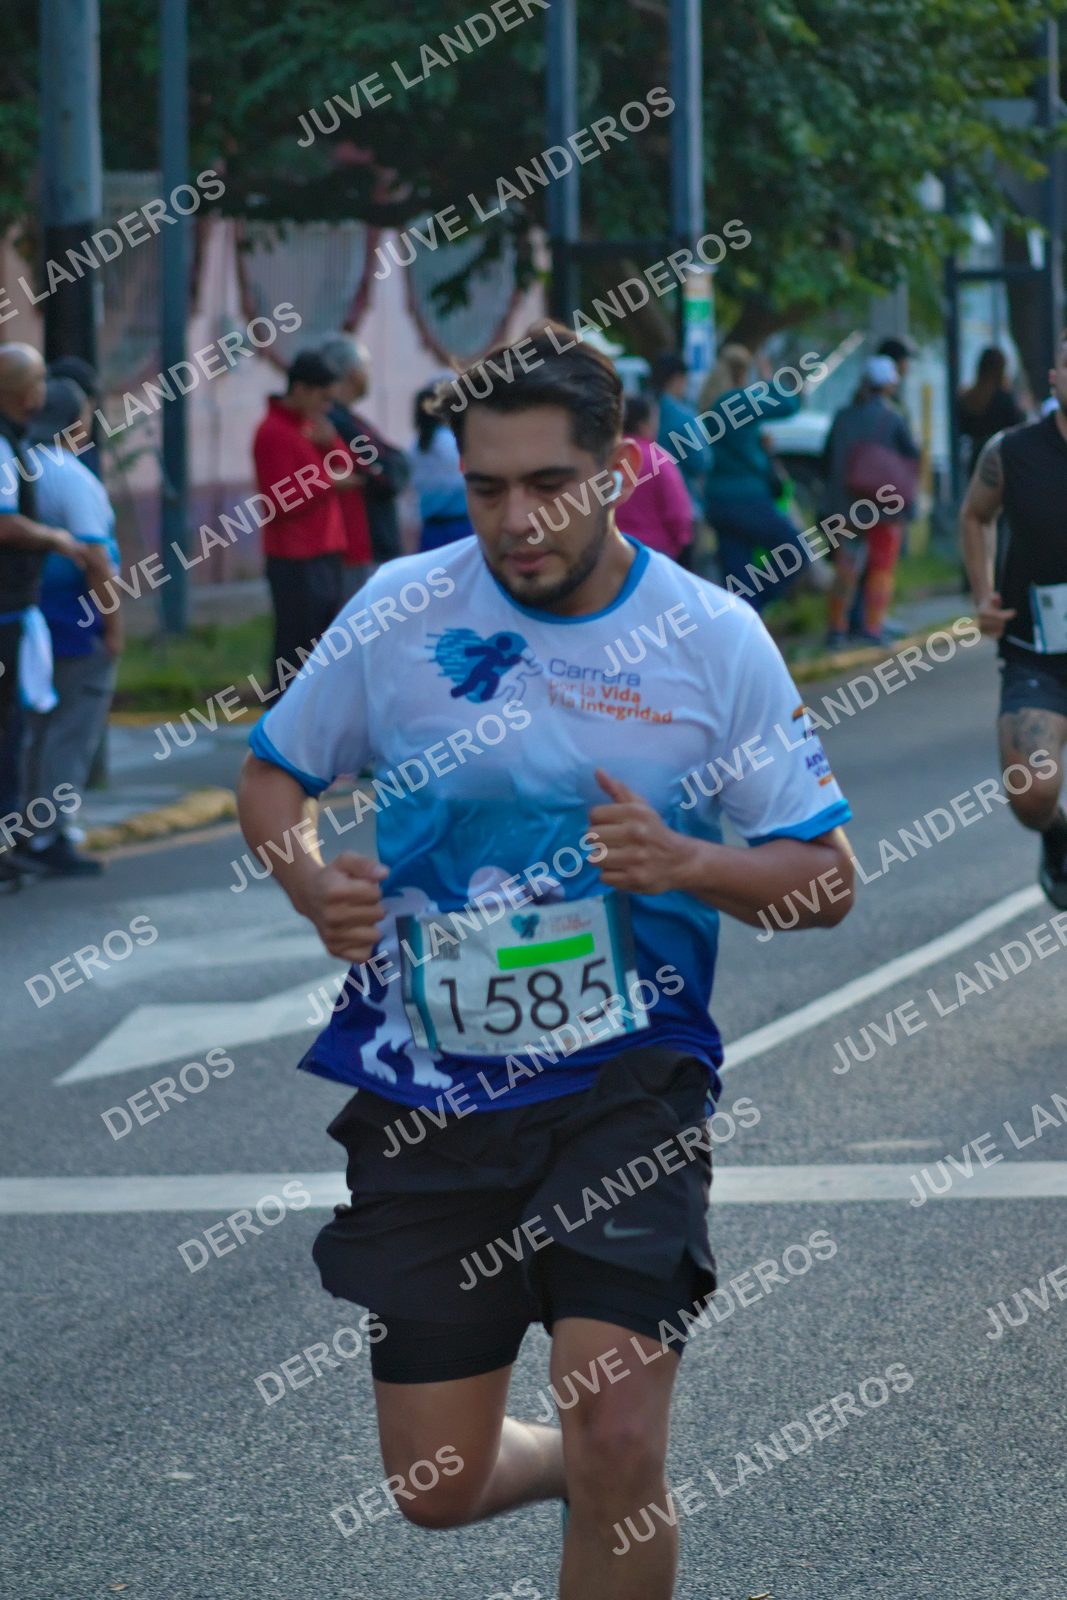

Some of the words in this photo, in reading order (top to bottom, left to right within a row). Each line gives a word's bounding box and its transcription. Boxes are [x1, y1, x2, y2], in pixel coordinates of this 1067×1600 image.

[601, 685, 641, 703] Vida
[581, 701, 673, 724] Integridad
[439, 958, 612, 1035] 1585
